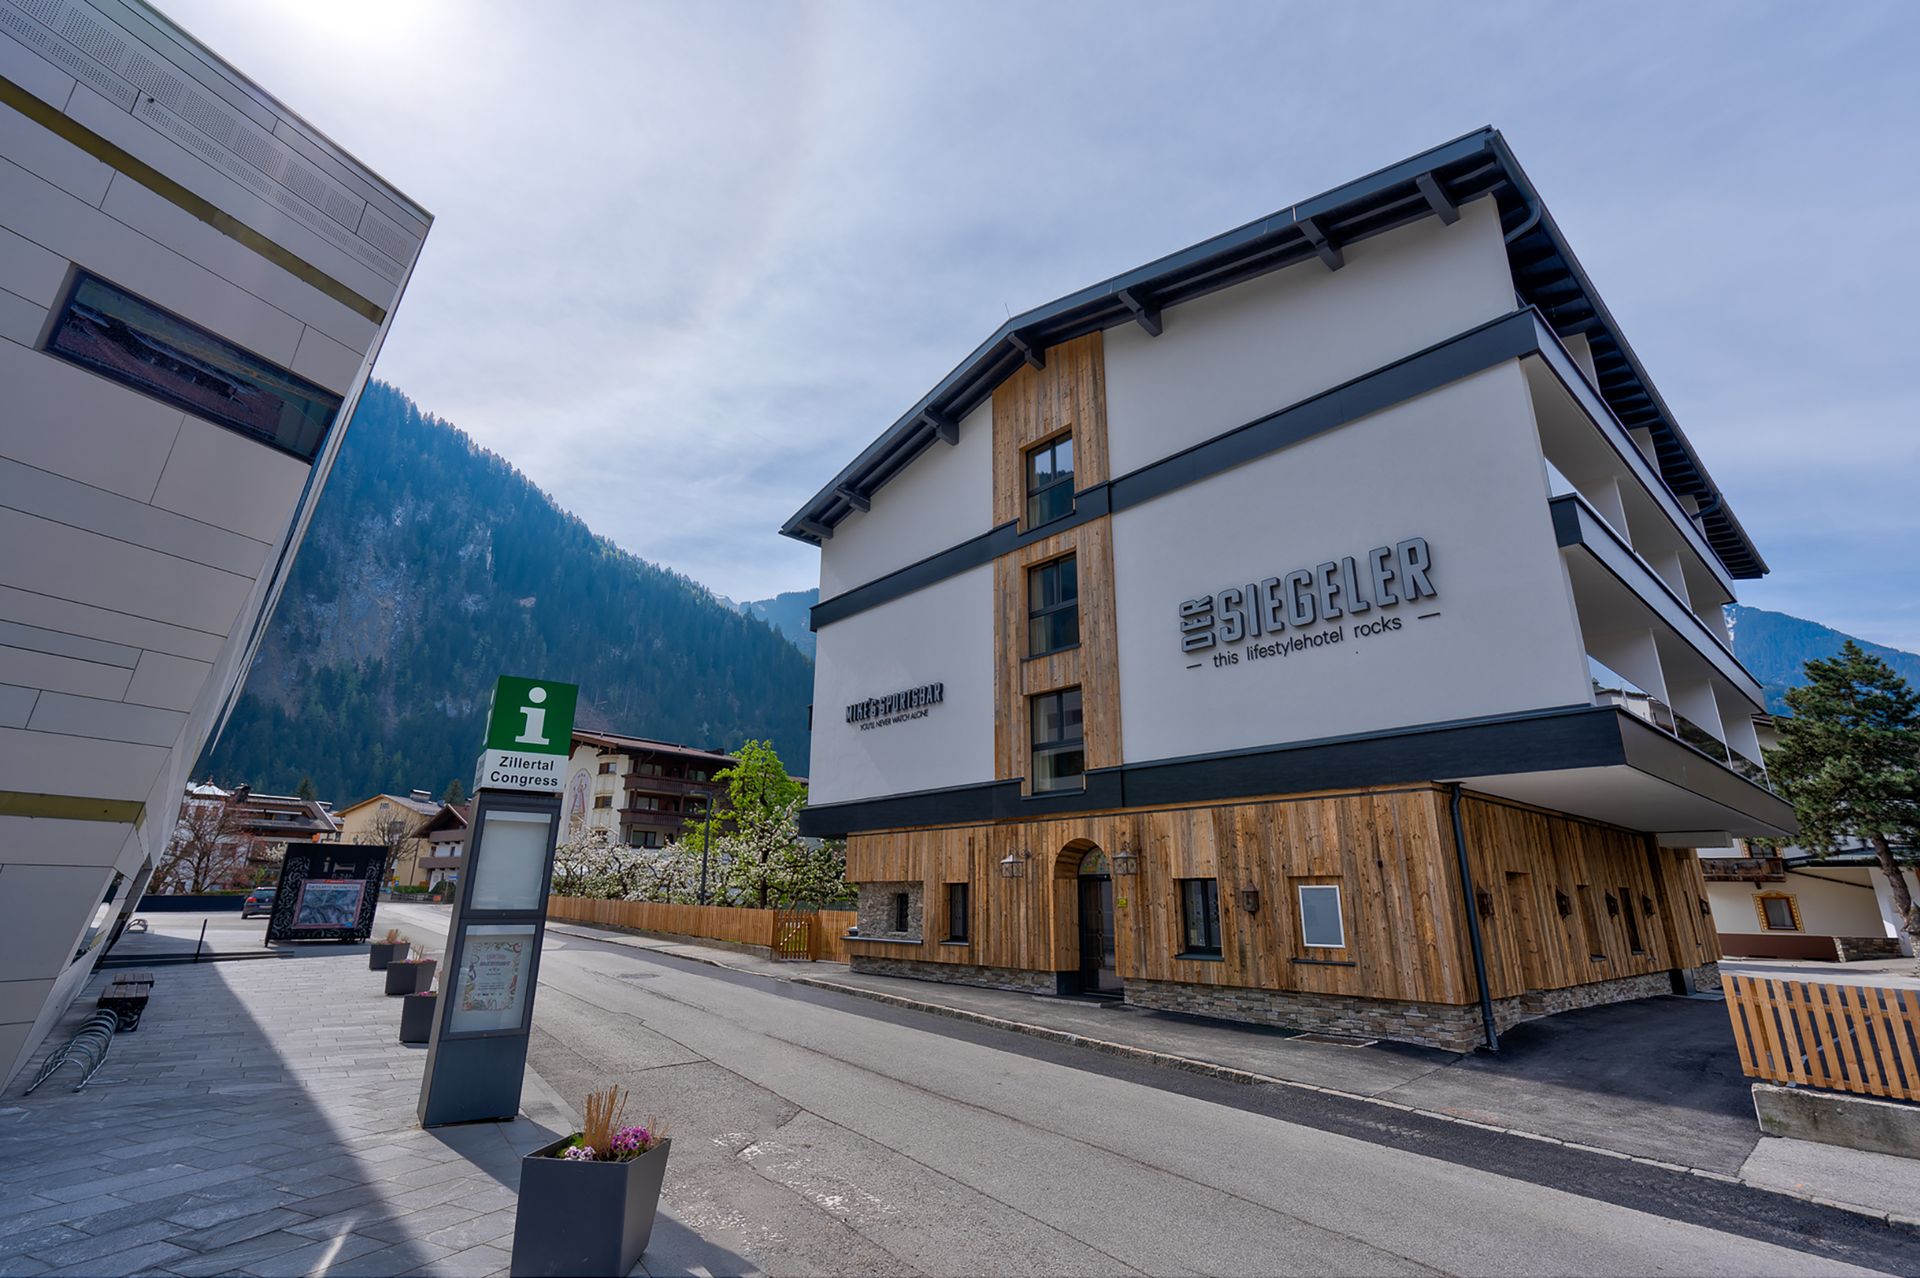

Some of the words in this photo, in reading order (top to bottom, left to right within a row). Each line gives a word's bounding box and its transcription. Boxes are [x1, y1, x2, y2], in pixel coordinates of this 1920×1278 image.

[1217, 537, 1437, 642] SIEGELER
[1179, 595, 1216, 653] DER
[1213, 652, 1239, 668] this
[1246, 627, 1344, 661] lifestylehotel
[1354, 616, 1402, 639] rocks
[880, 682, 944, 715] SPORTSBAR
[875, 718, 892, 728] NEVER
[892, 714, 910, 723] WATCH
[910, 709, 929, 720] ALONE
[490, 770, 558, 787] Congress
[499, 756, 554, 771] Zillertal
